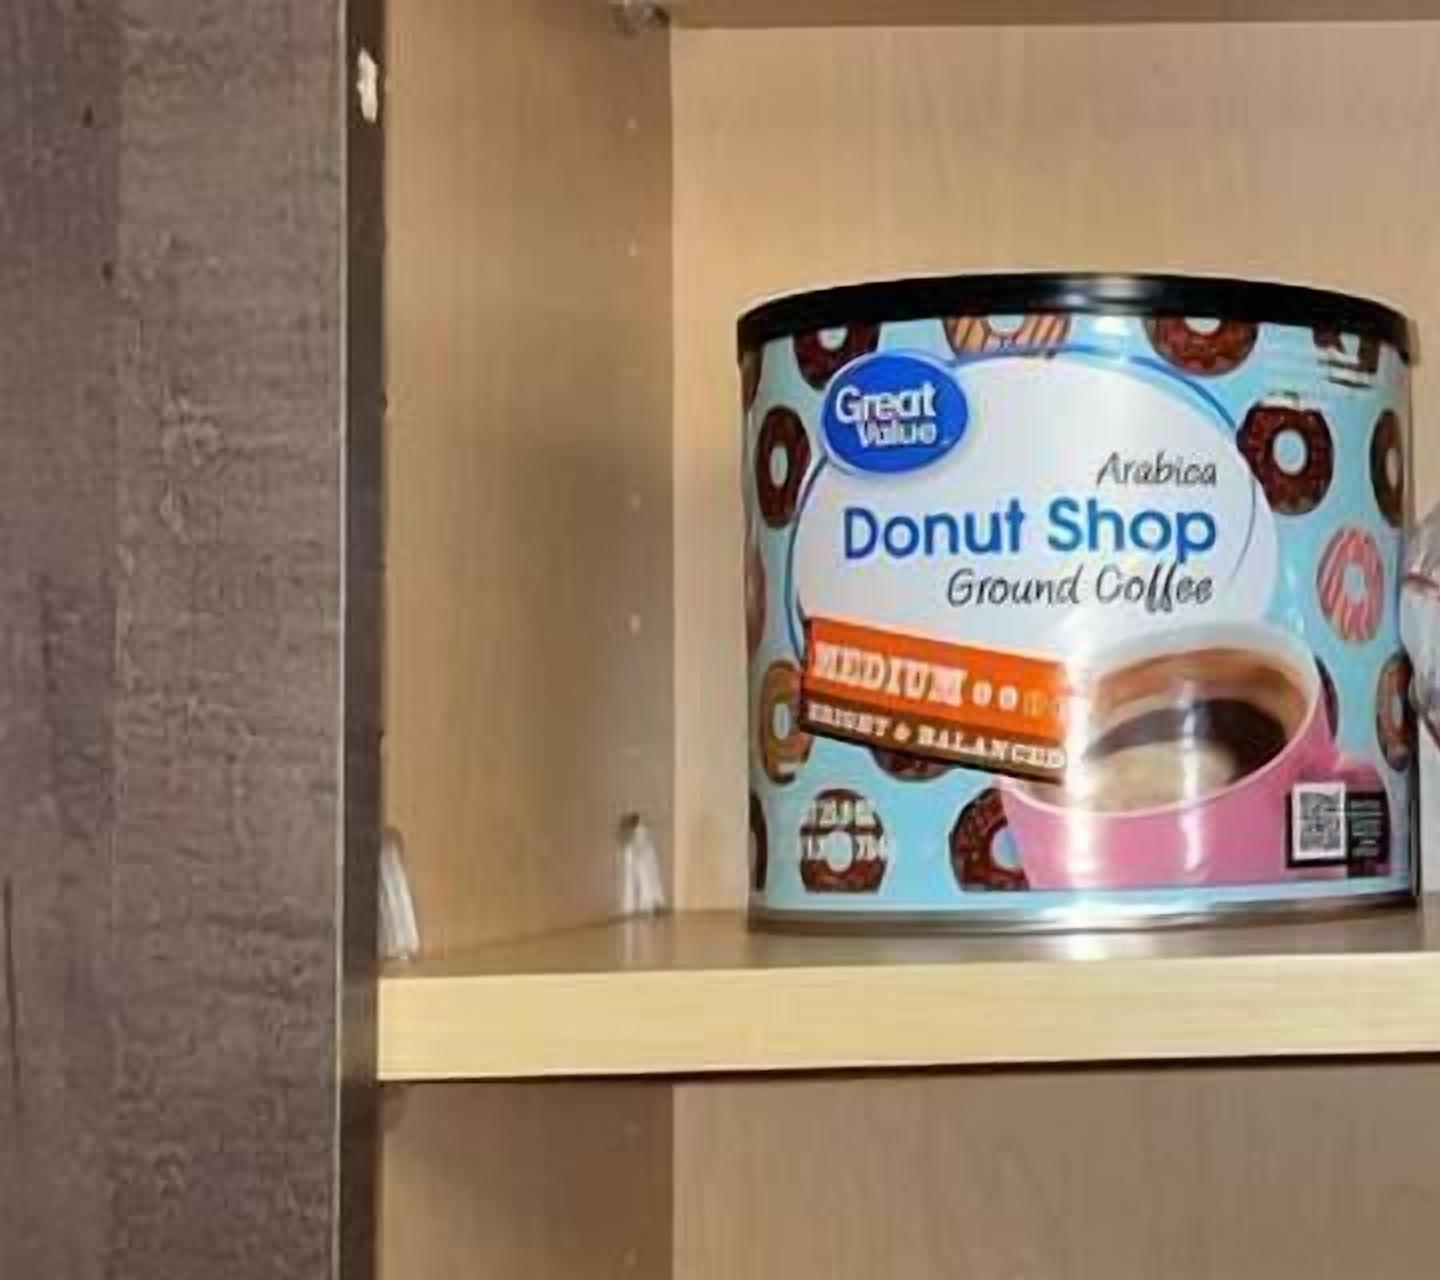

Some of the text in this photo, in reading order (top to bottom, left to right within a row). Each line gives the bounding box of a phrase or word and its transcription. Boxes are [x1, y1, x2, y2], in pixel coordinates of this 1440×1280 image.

[836, 380, 936, 424] Great
[856, 418, 937, 449] Value
[1095, 451, 1217, 488] Arabica
[844, 496, 1216, 563] Donut Shop
[946, 562, 1213, 613] Ground Coffee
[813, 640, 969, 707] MEDIUM
[917, 724, 1066, 769] BALANCED
